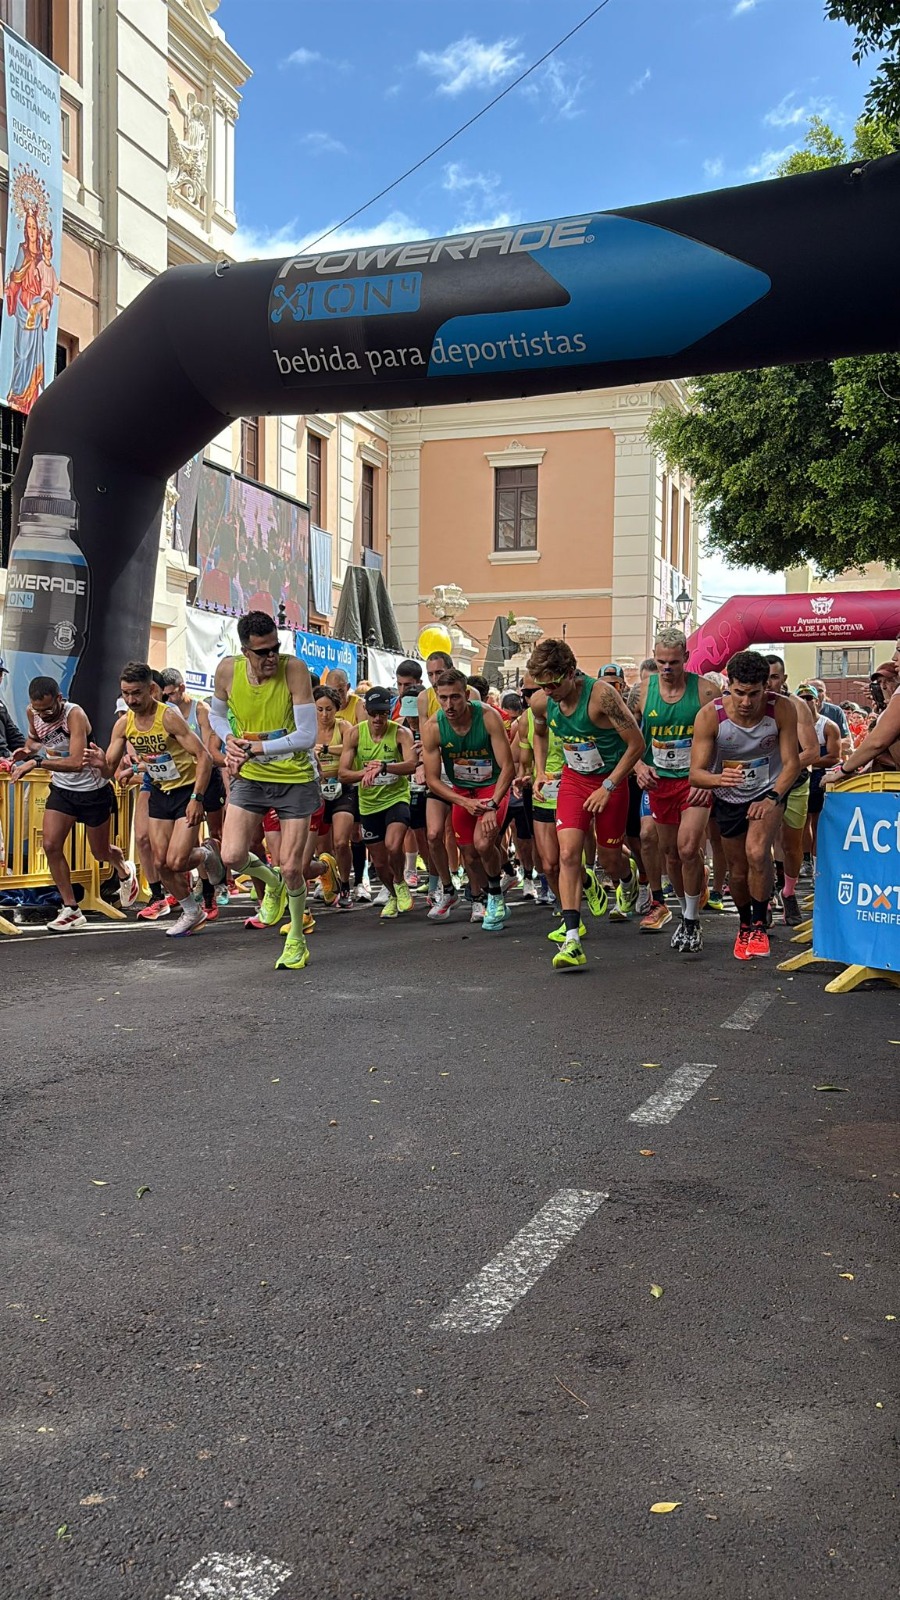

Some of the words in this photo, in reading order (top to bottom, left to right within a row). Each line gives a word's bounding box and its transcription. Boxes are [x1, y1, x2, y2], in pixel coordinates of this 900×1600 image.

[8, 43, 33, 70] MARÍA
[9, 59, 57, 103] AUXILIADORA
[10, 72, 20, 87] DE
[20, 81, 35, 98] LOS
[10, 88, 51, 125] CRISTIANOS
[12, 118, 37, 142] RUEGA
[38, 134, 52, 154] POR
[13, 132, 50, 166] NOSOTROS
[273, 345, 361, 374] bebida
[365, 346, 426, 375] para
[430, 331, 587, 369] deportistas
[780, 625, 804, 633] VILLA
[828, 623, 864, 631] OROTAVA
[797, 616, 847, 625] Ayuntamiento
[301, 638, 326, 659] Activa
[327, 644, 336, 661] tu
[337, 647, 352, 665] vida
[129, 734, 165, 745] CORRE
[574, 752, 583, 761] 3
[667, 750, 676, 759] 6
[147, 764, 168, 773] 239
[465, 766, 479, 774] 11
[323, 785, 336, 793] 45
[856, 909, 900, 925] TENERIFE
